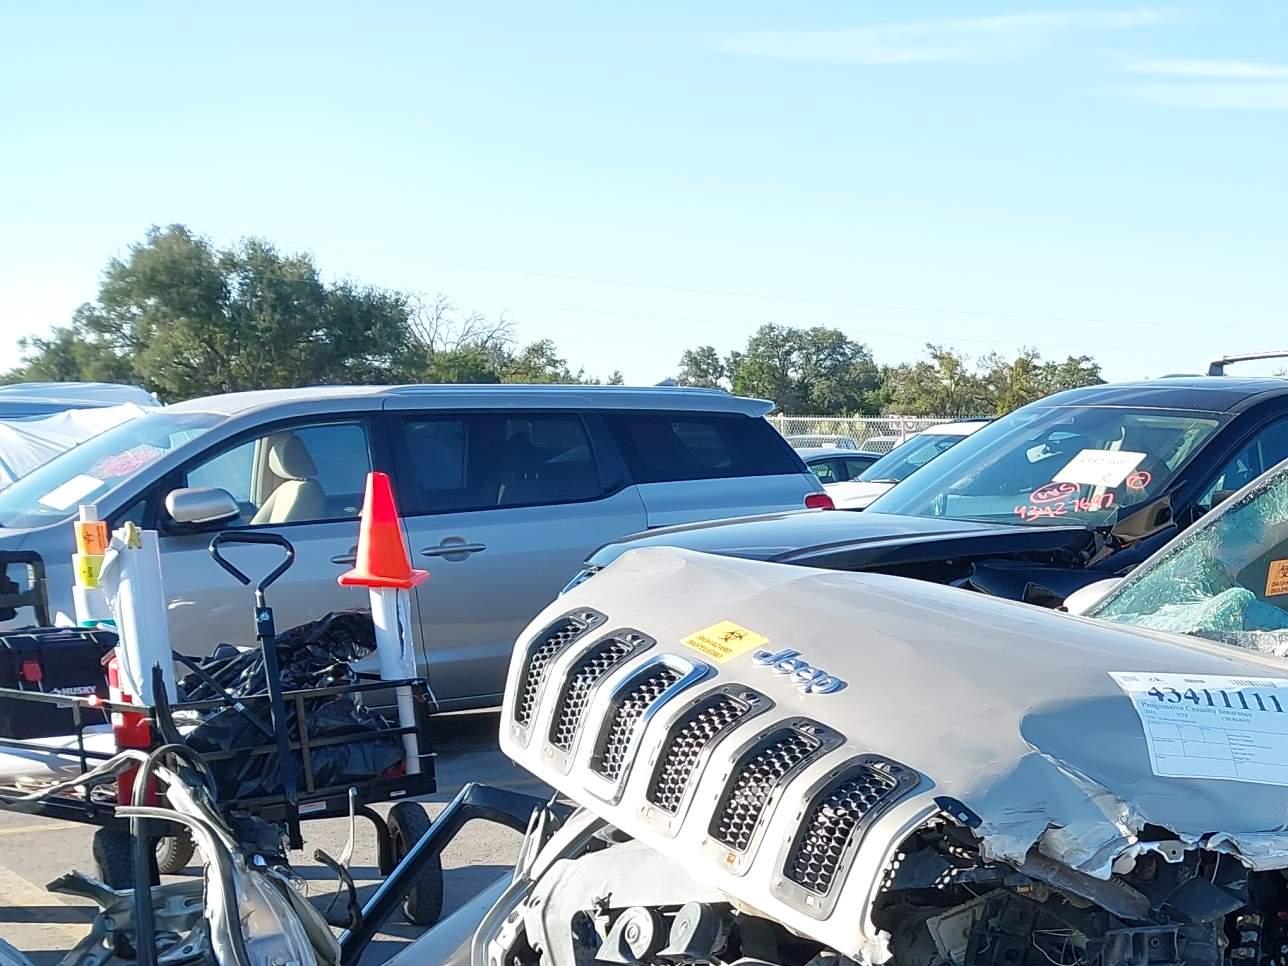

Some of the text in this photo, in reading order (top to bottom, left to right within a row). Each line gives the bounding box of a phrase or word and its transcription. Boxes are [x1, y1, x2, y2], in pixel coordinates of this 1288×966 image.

[751, 647, 849, 695] Jeep
[61, 686, 97, 696] HUSKY
[1147, 686, 1286, 713] 43411111
[1141, 701, 1184, 713] Progressive
